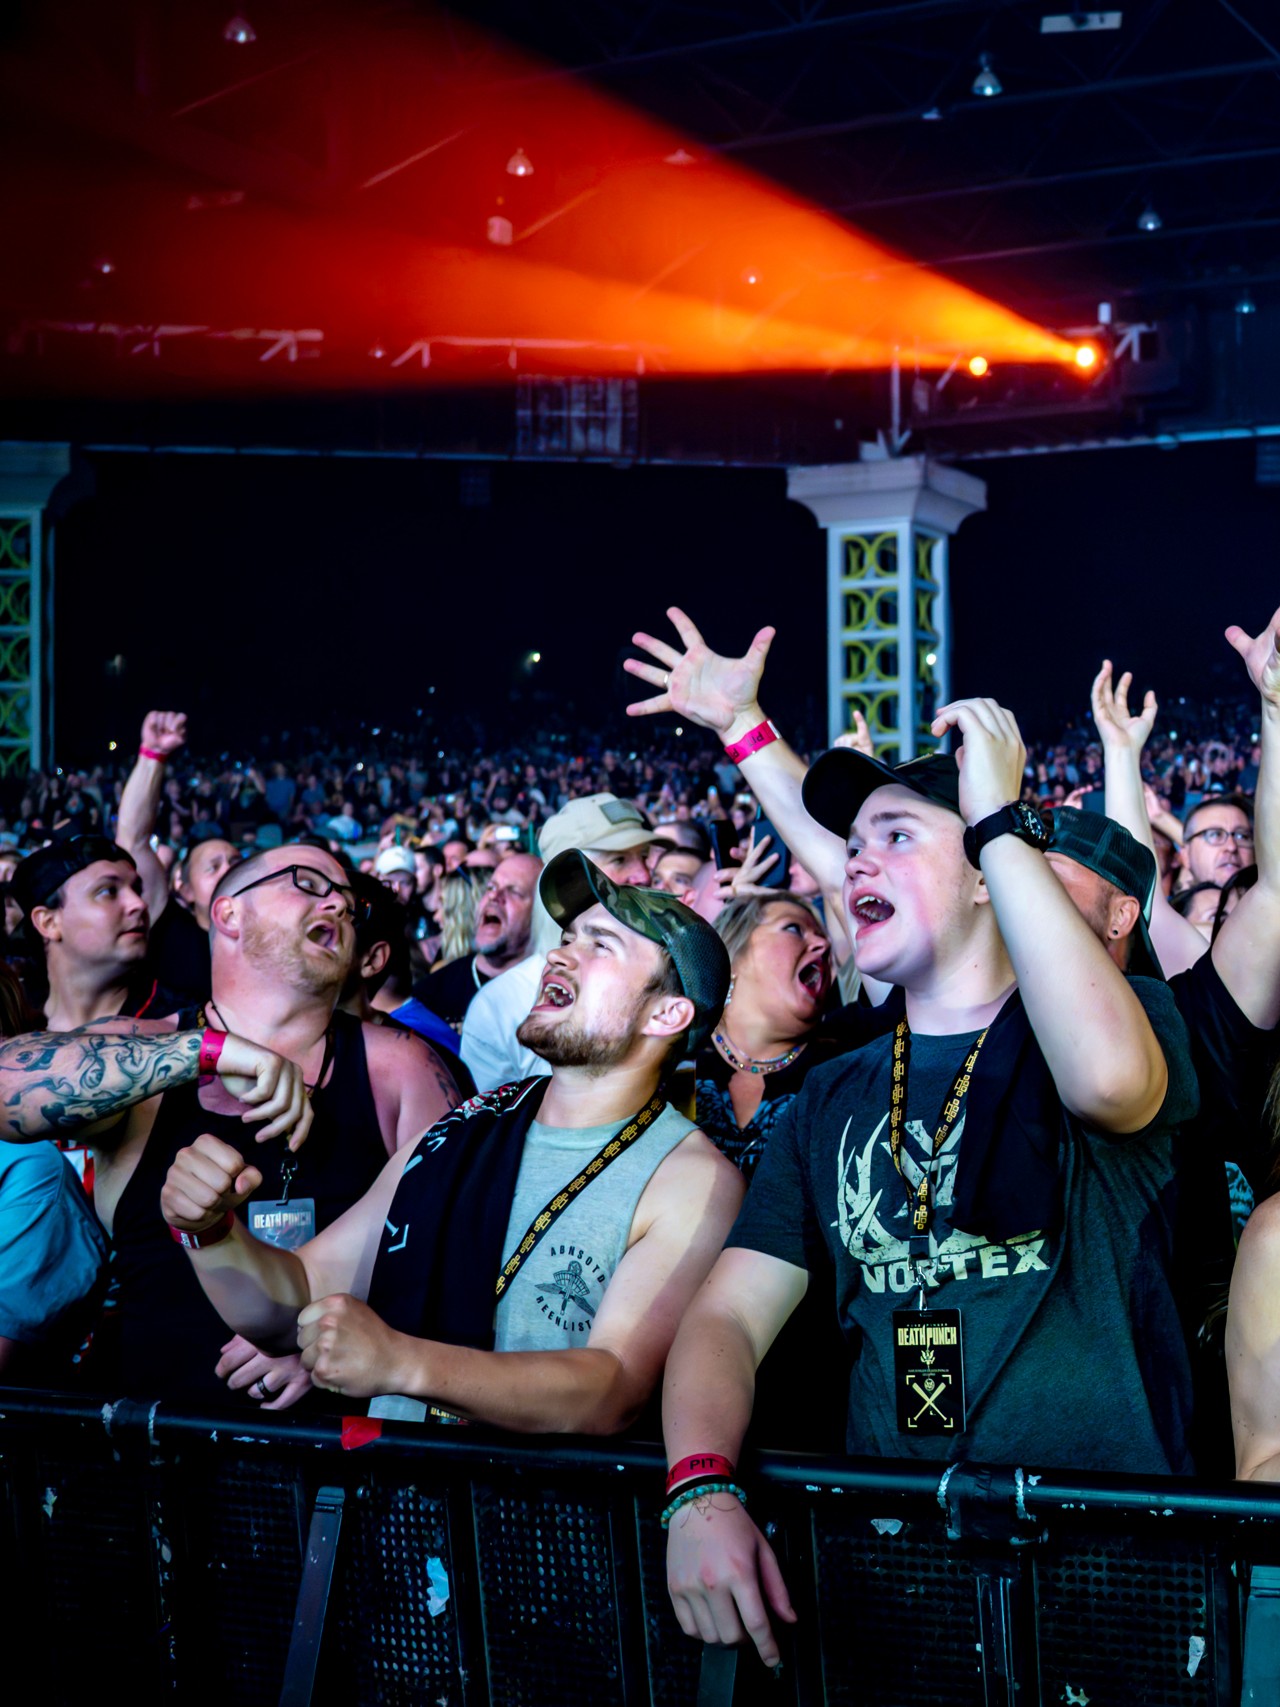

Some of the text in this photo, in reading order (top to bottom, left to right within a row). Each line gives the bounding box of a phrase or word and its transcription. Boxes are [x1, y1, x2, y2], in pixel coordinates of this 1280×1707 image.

[253, 1211, 282, 1229] DEATH
[860, 1239, 1051, 1293] VORTEX
[897, 1324, 958, 1348] DEATH PUNCH
[690, 1458, 718, 1470] PIT
